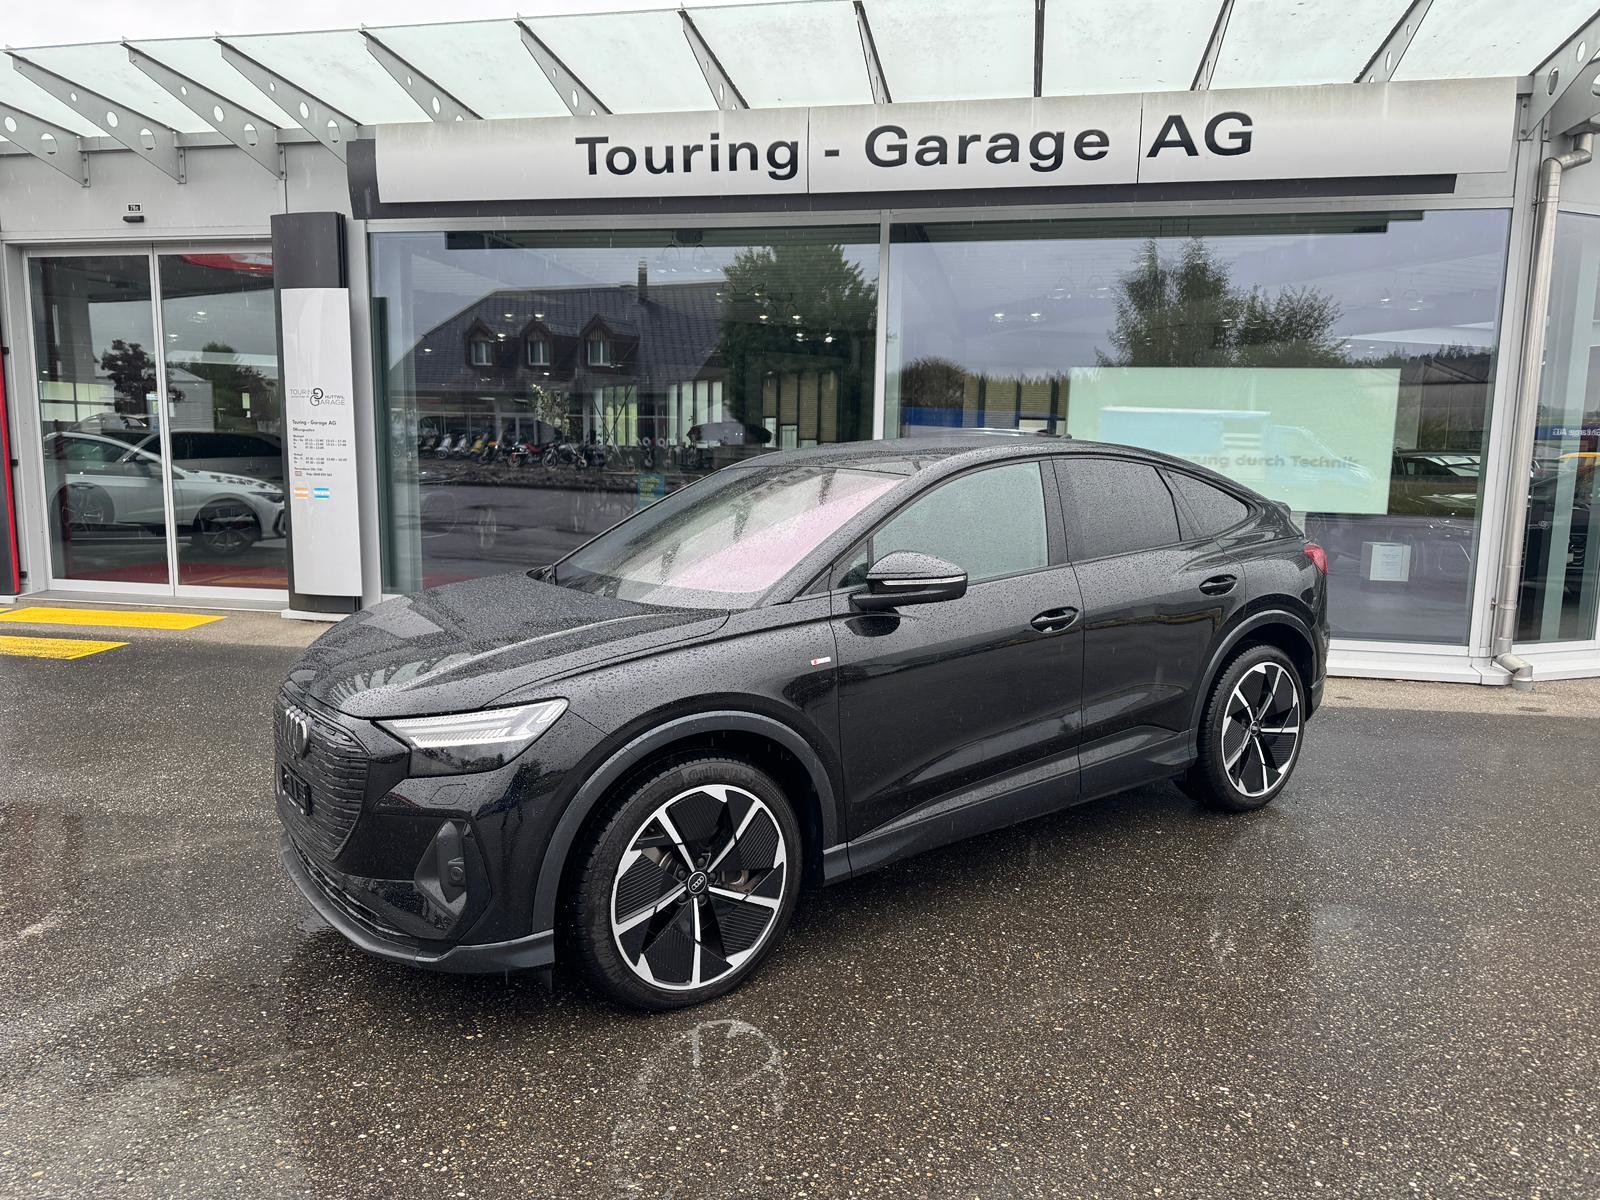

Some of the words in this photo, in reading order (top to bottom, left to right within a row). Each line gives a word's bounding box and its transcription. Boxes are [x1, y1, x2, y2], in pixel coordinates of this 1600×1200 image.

[575, 132, 799, 181] Touring
[824, 149, 840, 158] -
[865, 124, 1110, 173] Garage
[1146, 111, 1253, 158] AG
[1234, 454, 1286, 467] durch
[1289, 455, 1360, 469] Technik
